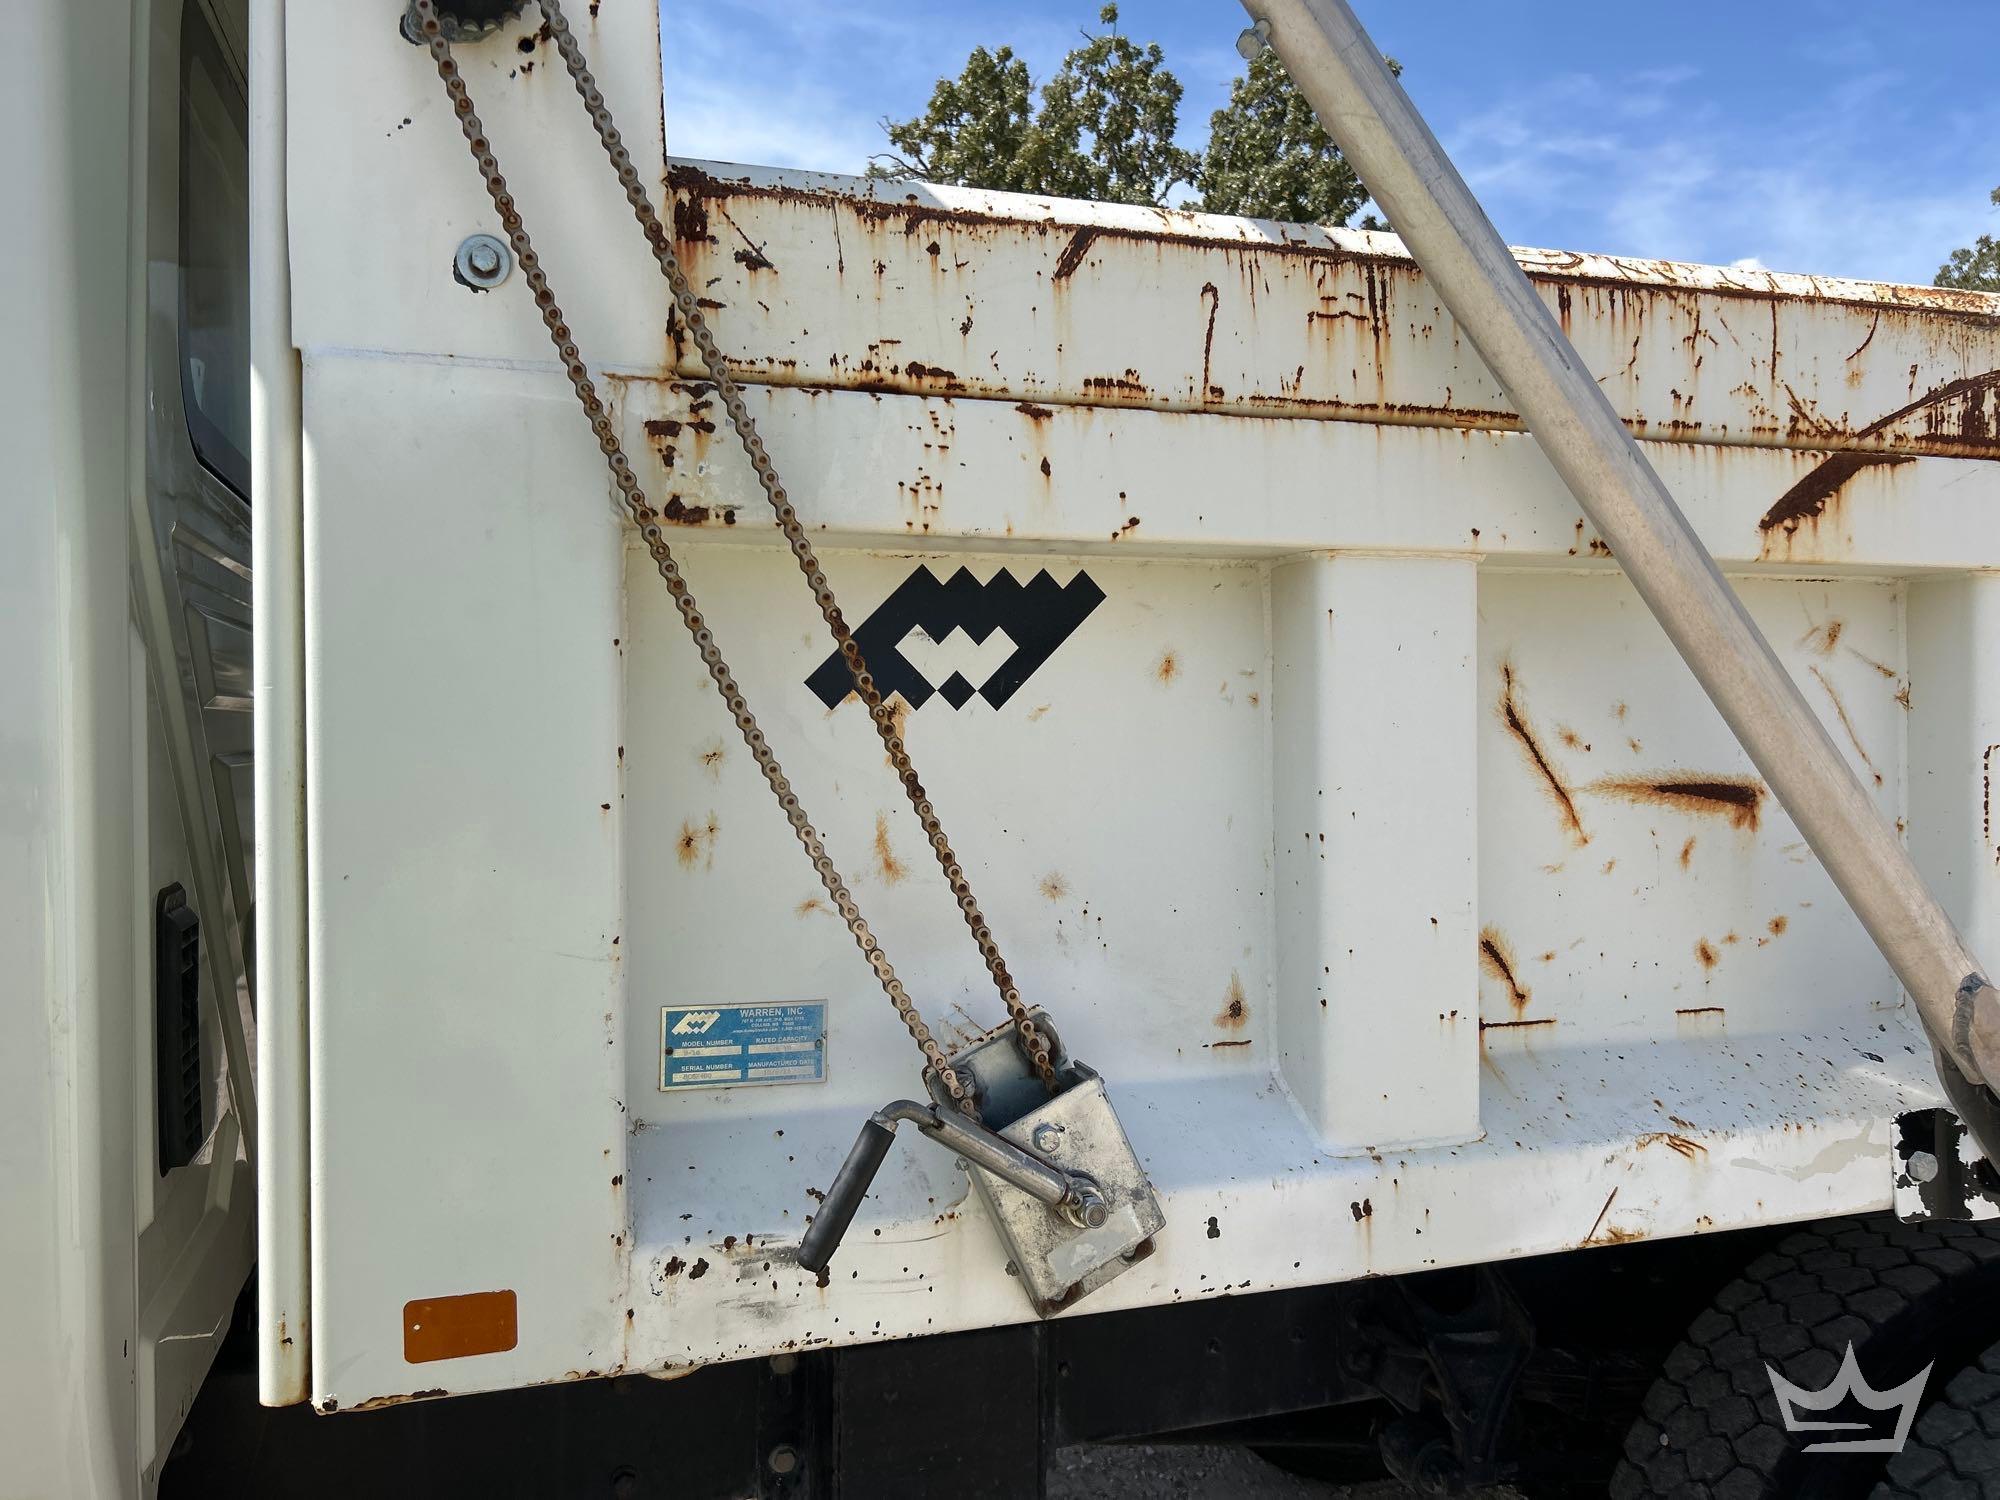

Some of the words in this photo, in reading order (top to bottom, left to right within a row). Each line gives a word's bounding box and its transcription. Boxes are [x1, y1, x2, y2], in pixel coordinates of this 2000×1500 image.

[740, 1008, 784, 1017] WARREN,
[787, 1007, 806, 1015] INC.
[778, 1035, 808, 1043] CAPACITY
[748, 1060, 798, 1068] MANUFACTURED
